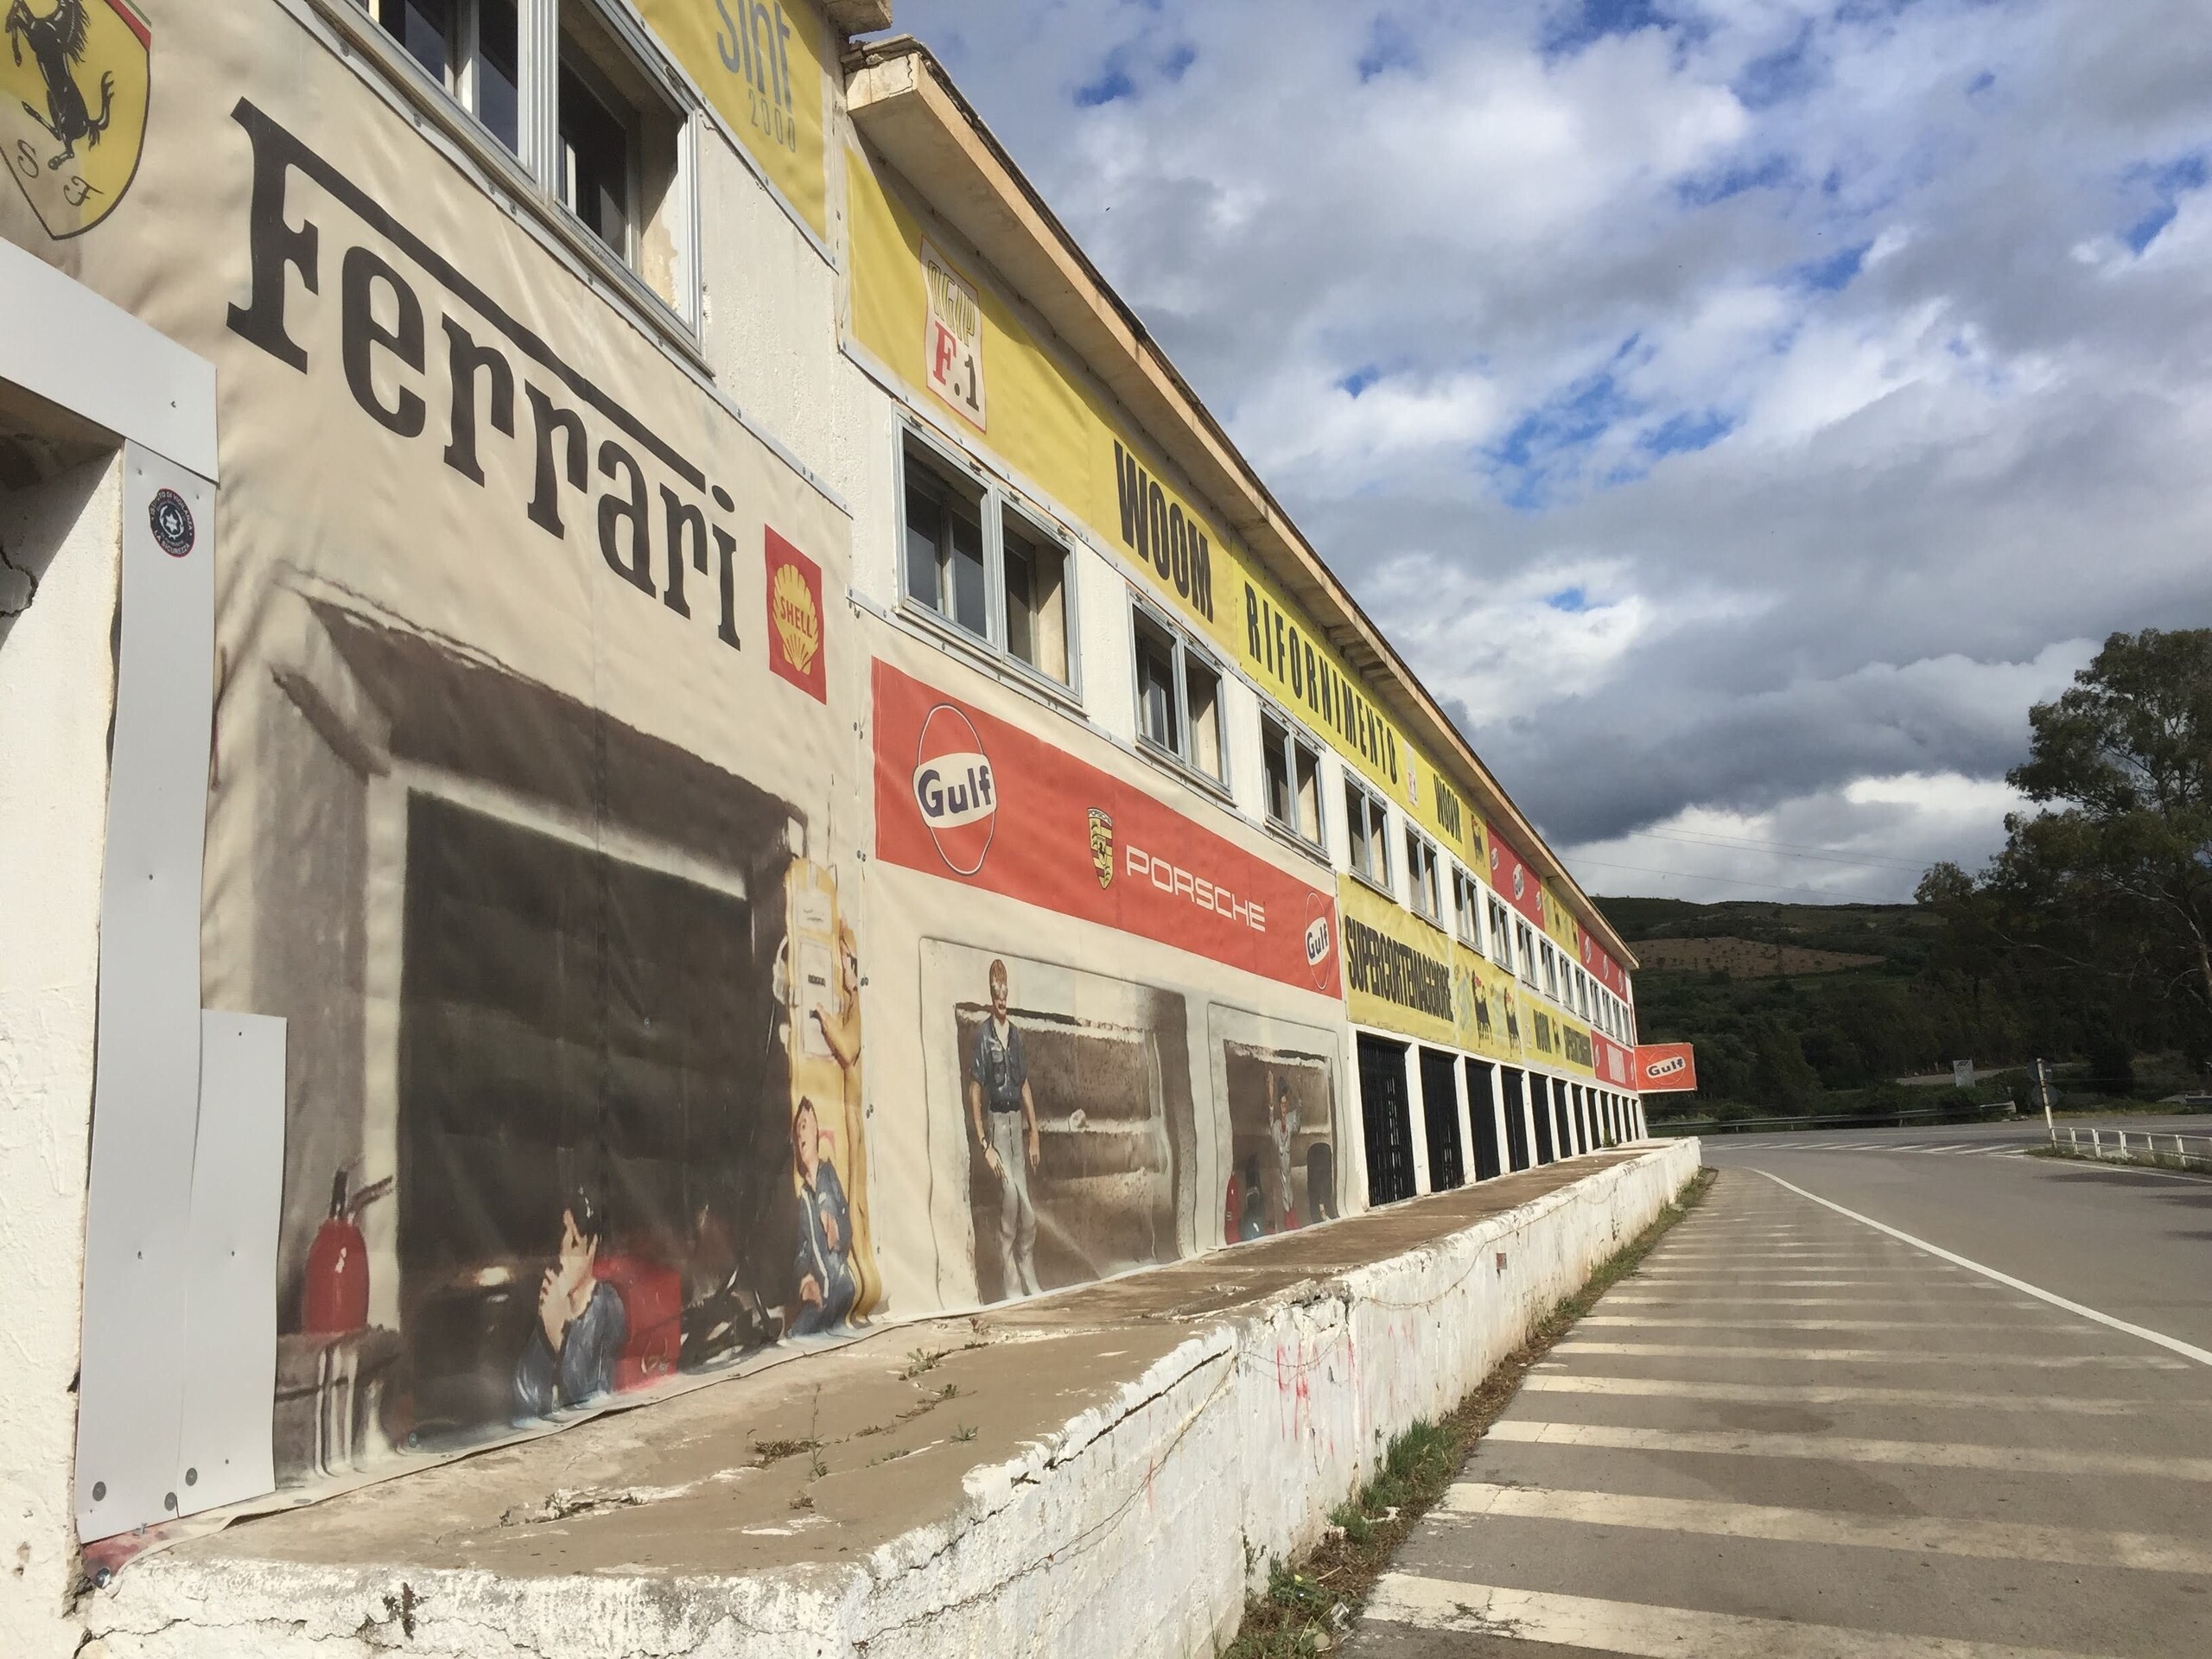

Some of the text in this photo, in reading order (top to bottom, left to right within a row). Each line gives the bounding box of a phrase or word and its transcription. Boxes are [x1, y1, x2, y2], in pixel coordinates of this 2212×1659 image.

[748, 89, 796, 154] 2000
[17, 139, 40, 179] S
[927, 259, 976, 347] AGIP
[226, 97, 741, 652] Ferrari
[149, 492, 166, 516] ISTIUTO
[173, 494, 193, 530] VIGILANZA
[1114, 439, 1214, 624] WOOM
[780, 595, 813, 639] SHELL
[1244, 581, 1398, 785] RIFORNIMENTO
[918, 765, 991, 818] Gulf
[1126, 844, 1267, 933] PORSCHE
[1307, 923, 1328, 959] Gulf
[1648, 1058, 1683, 1077] Gulf
